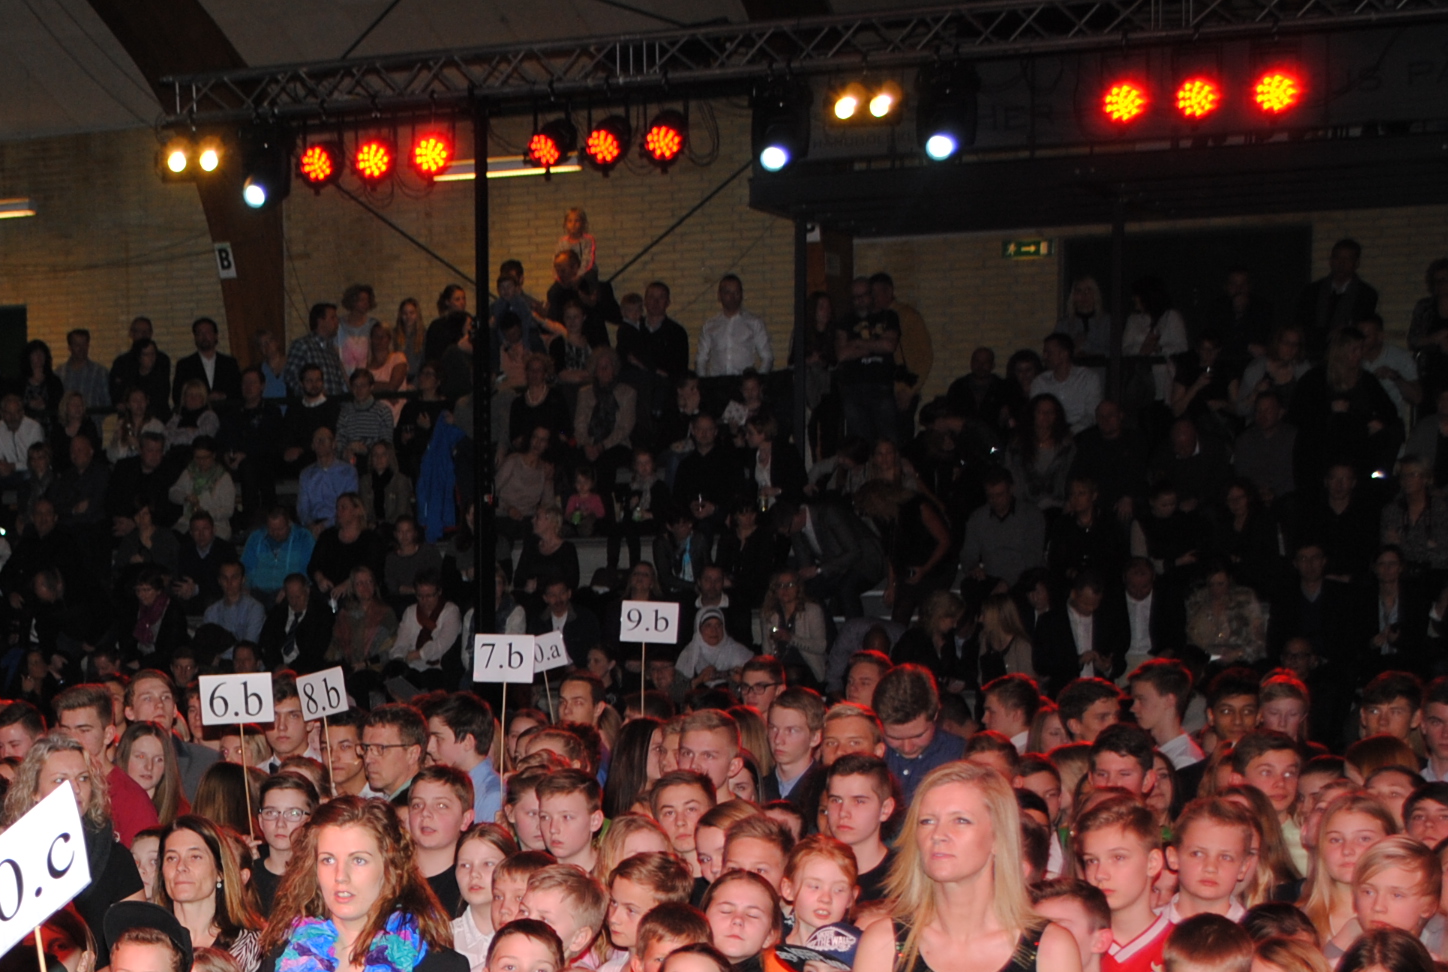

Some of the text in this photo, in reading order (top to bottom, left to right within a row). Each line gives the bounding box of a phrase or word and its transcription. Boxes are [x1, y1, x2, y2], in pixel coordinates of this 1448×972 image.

[219, 248, 231, 270] B
[626, 608, 670, 633] 9.b
[480, 643, 524, 669] 7.b
[209, 681, 263, 718] 6.b
[303, 677, 342, 715] 8.b
